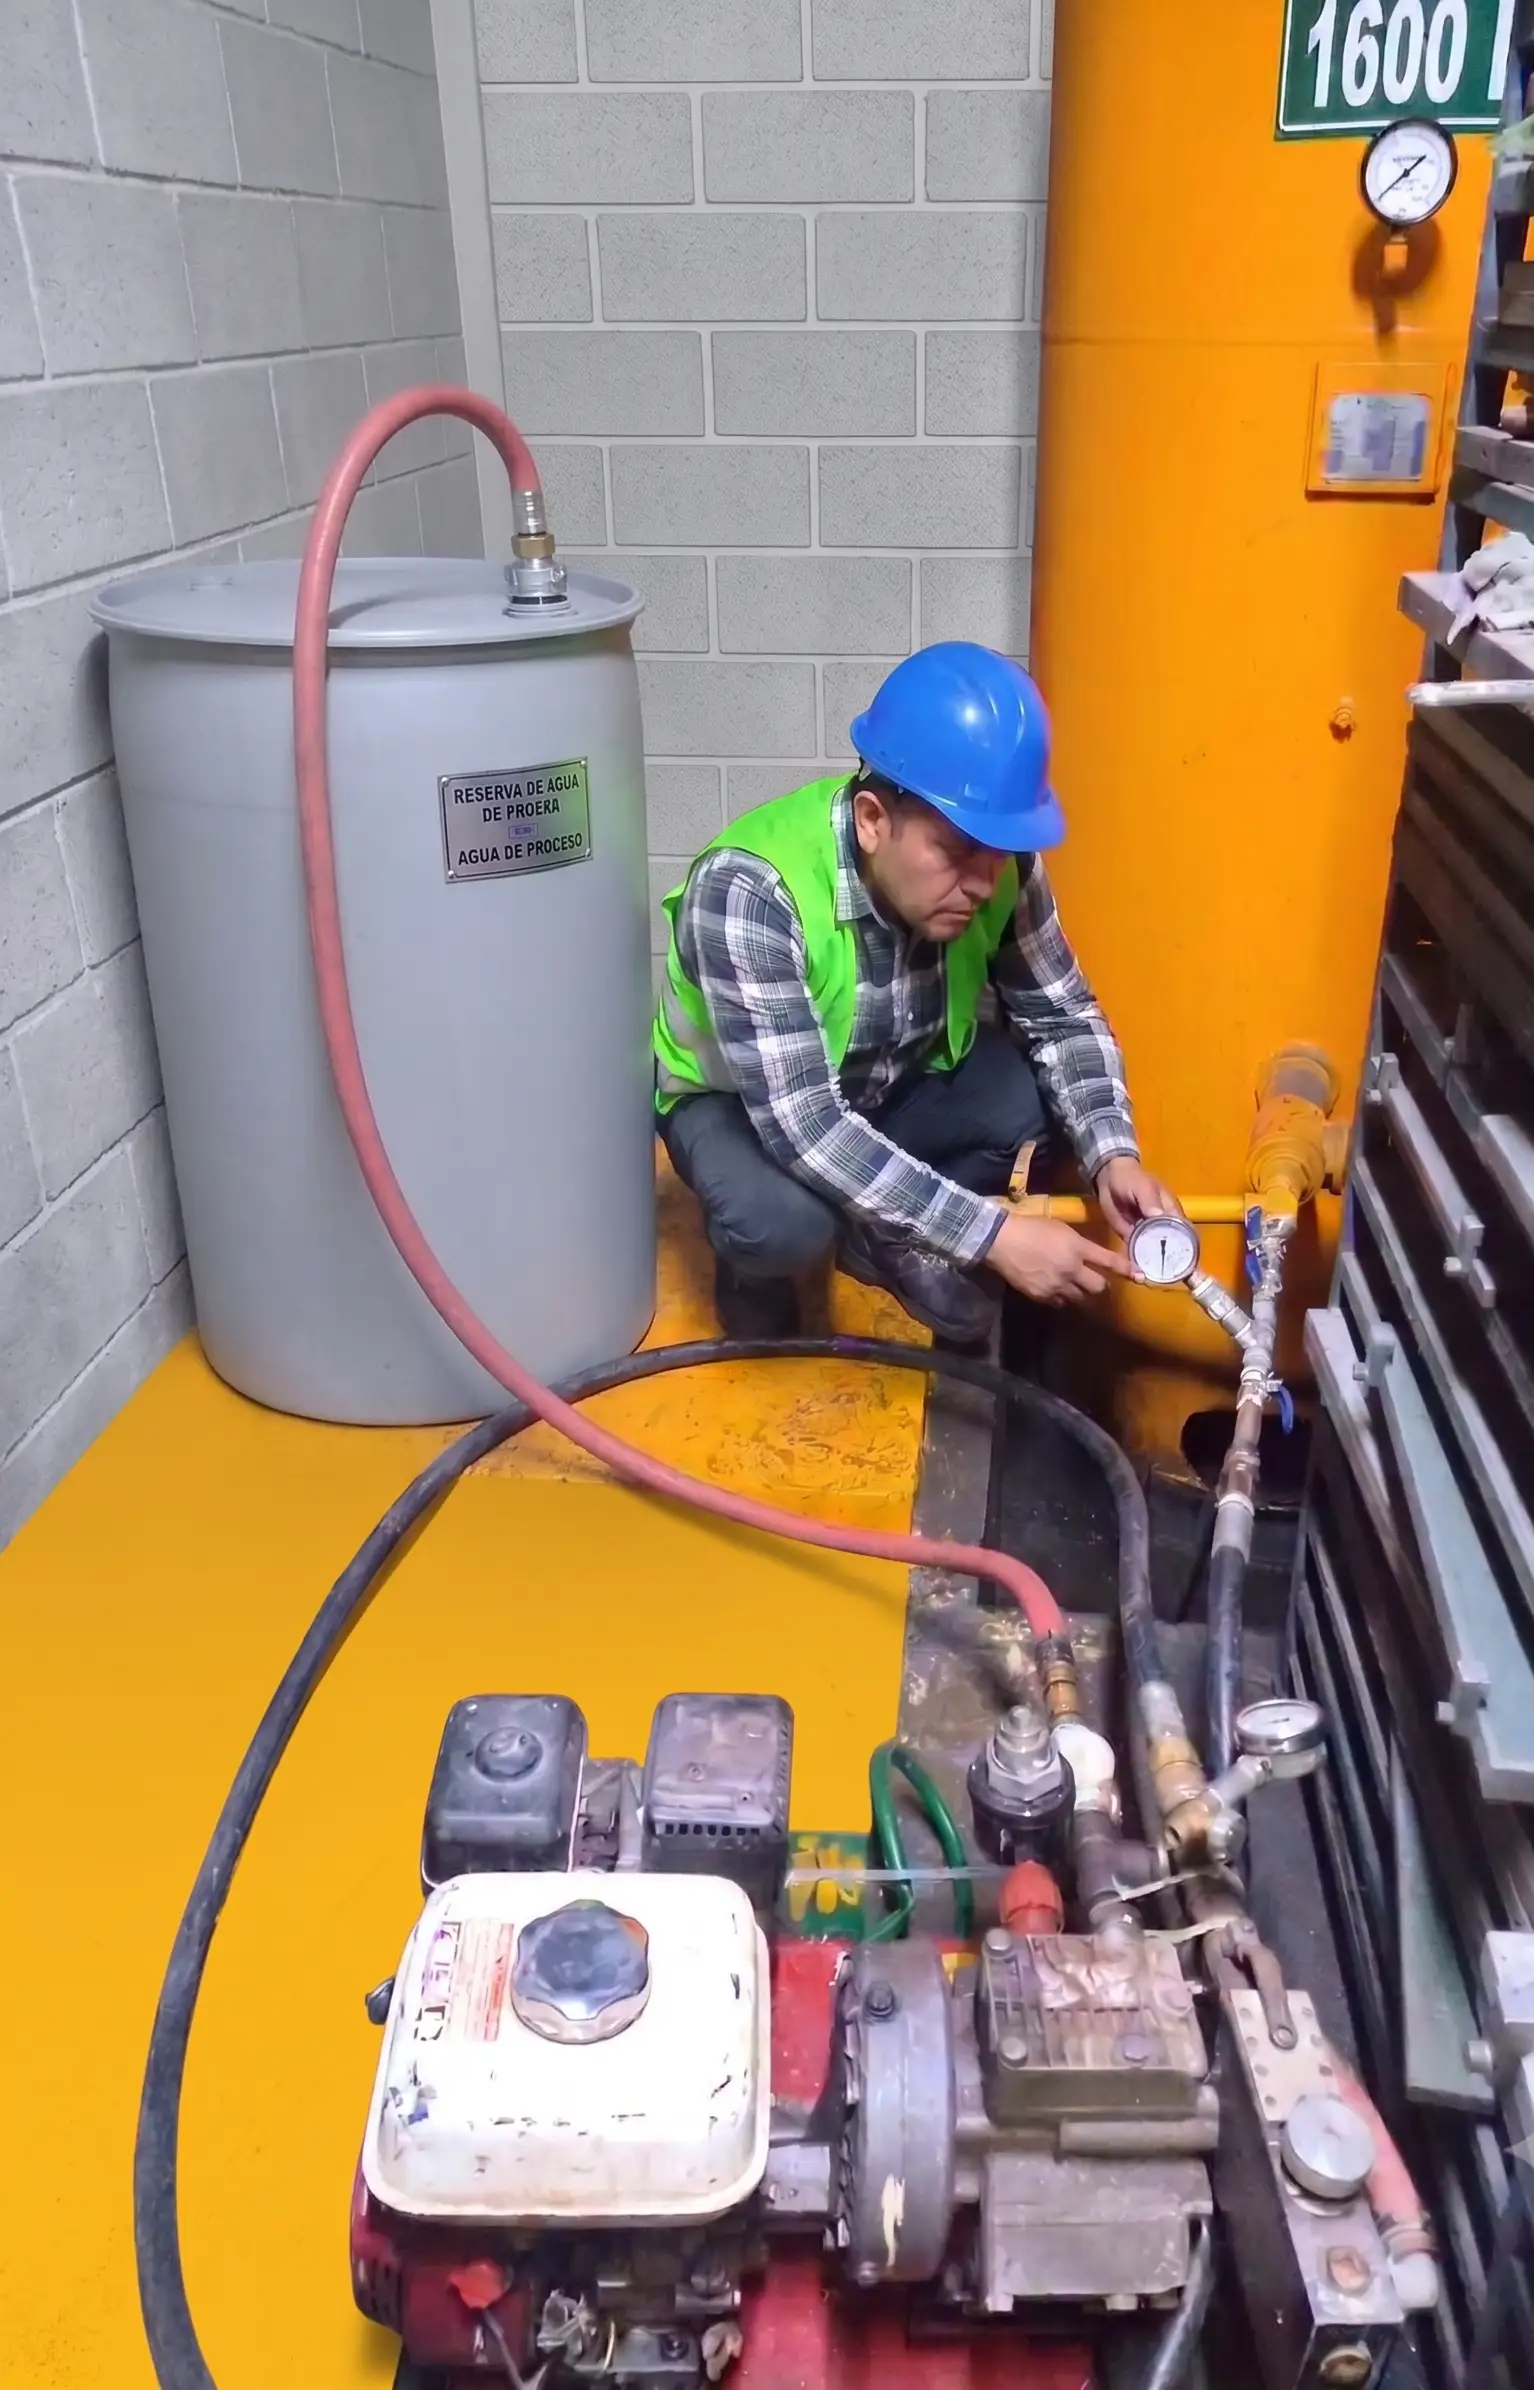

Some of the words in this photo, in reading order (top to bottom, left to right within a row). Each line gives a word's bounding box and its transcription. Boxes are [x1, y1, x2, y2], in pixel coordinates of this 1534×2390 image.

[1307, 0, 1468, 108] 1600
[454, 783, 523, 804] RESERVA
[526, 779, 544, 796] DE
[547, 773, 580, 793] AGUA
[482, 806, 502, 823] DE
[507, 798, 560, 820] PROERA
[458, 847, 501, 866] AGUA
[504, 843, 523, 860] DE
[527, 833, 583, 857] PROCESO
